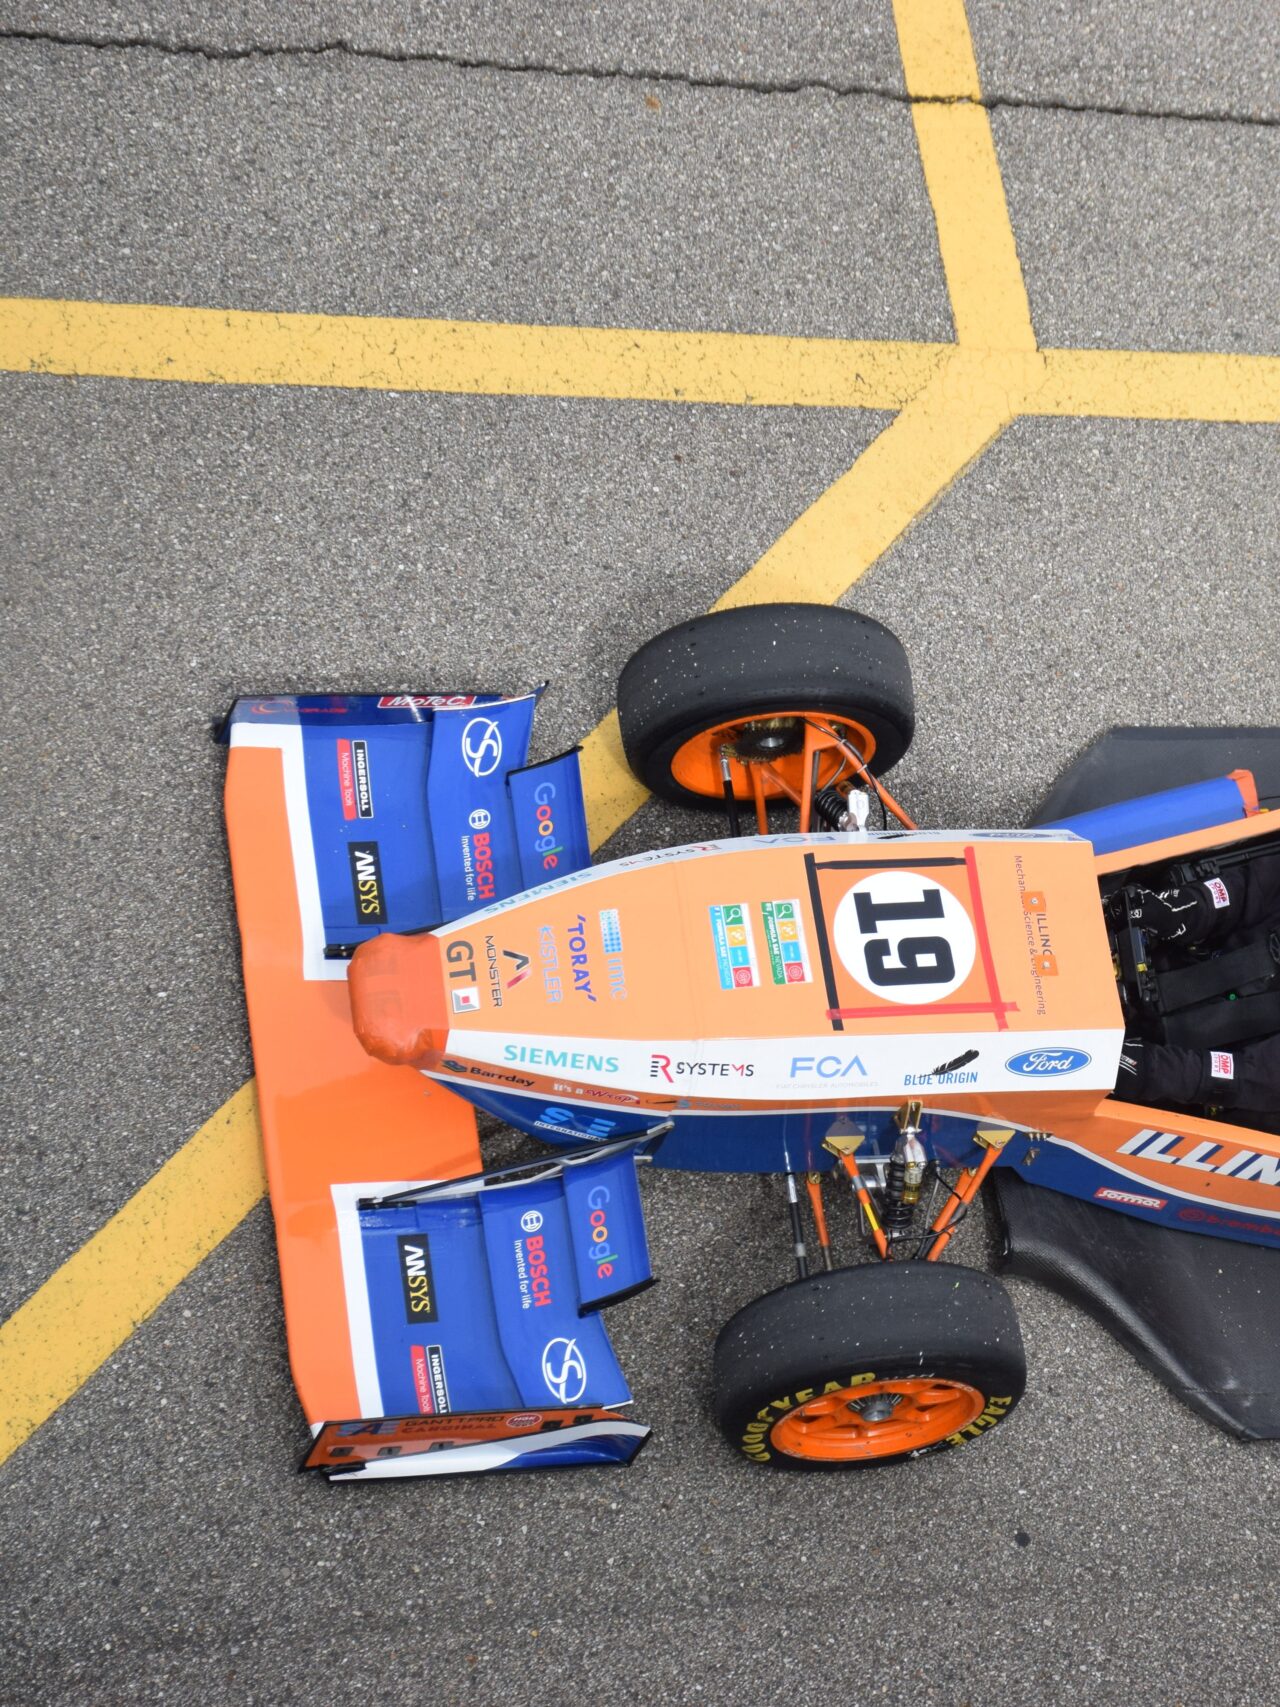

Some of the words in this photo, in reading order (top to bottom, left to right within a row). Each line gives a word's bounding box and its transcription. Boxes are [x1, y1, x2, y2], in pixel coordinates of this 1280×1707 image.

[341, 751, 350, 786] Machine
[356, 749, 370, 811] INGERSOLL
[533, 782, 564, 870] Google
[461, 835, 473, 871] Invented
[472, 831, 496, 900] BOSCH
[354, 850, 380, 915] ANSYS
[466, 872, 475, 886] for
[467, 888, 475, 901] life
[1014, 855, 1026, 908] Mechan
[1023, 911, 1035, 946] Science
[853, 889, 956, 986] 19
[1036, 913, 1053, 956] ILLINO
[446, 940, 477, 982] GT
[484, 935, 502, 1008] MONSTER
[538, 925, 563, 1004] KISTLER
[470, 1067, 535, 1086] Barrday
[503, 1044, 619, 1073] SIEMENS
[676, 1061, 755, 1077] SYSTEMS
[790, 1055, 868, 1078] FCA
[1022, 1051, 1074, 1071] Ford
[1220, 1054, 1230, 1074] OMP
[904, 1074, 933, 1086] BLUE
[937, 1072, 978, 1084] ORIGIN
[534, 1120, 609, 1142] INTERNATIONA
[588, 1185, 618, 1279] Google
[514, 1239, 528, 1279] Invented
[526, 1235, 552, 1307] BOSCH
[404, 1244, 431, 1314] ANSYS
[520, 1280, 529, 1294] for
[522, 1294, 532, 1309] life
[415, 1358, 426, 1393] Machine
[945, 1396, 1012, 1447] EAGLE
